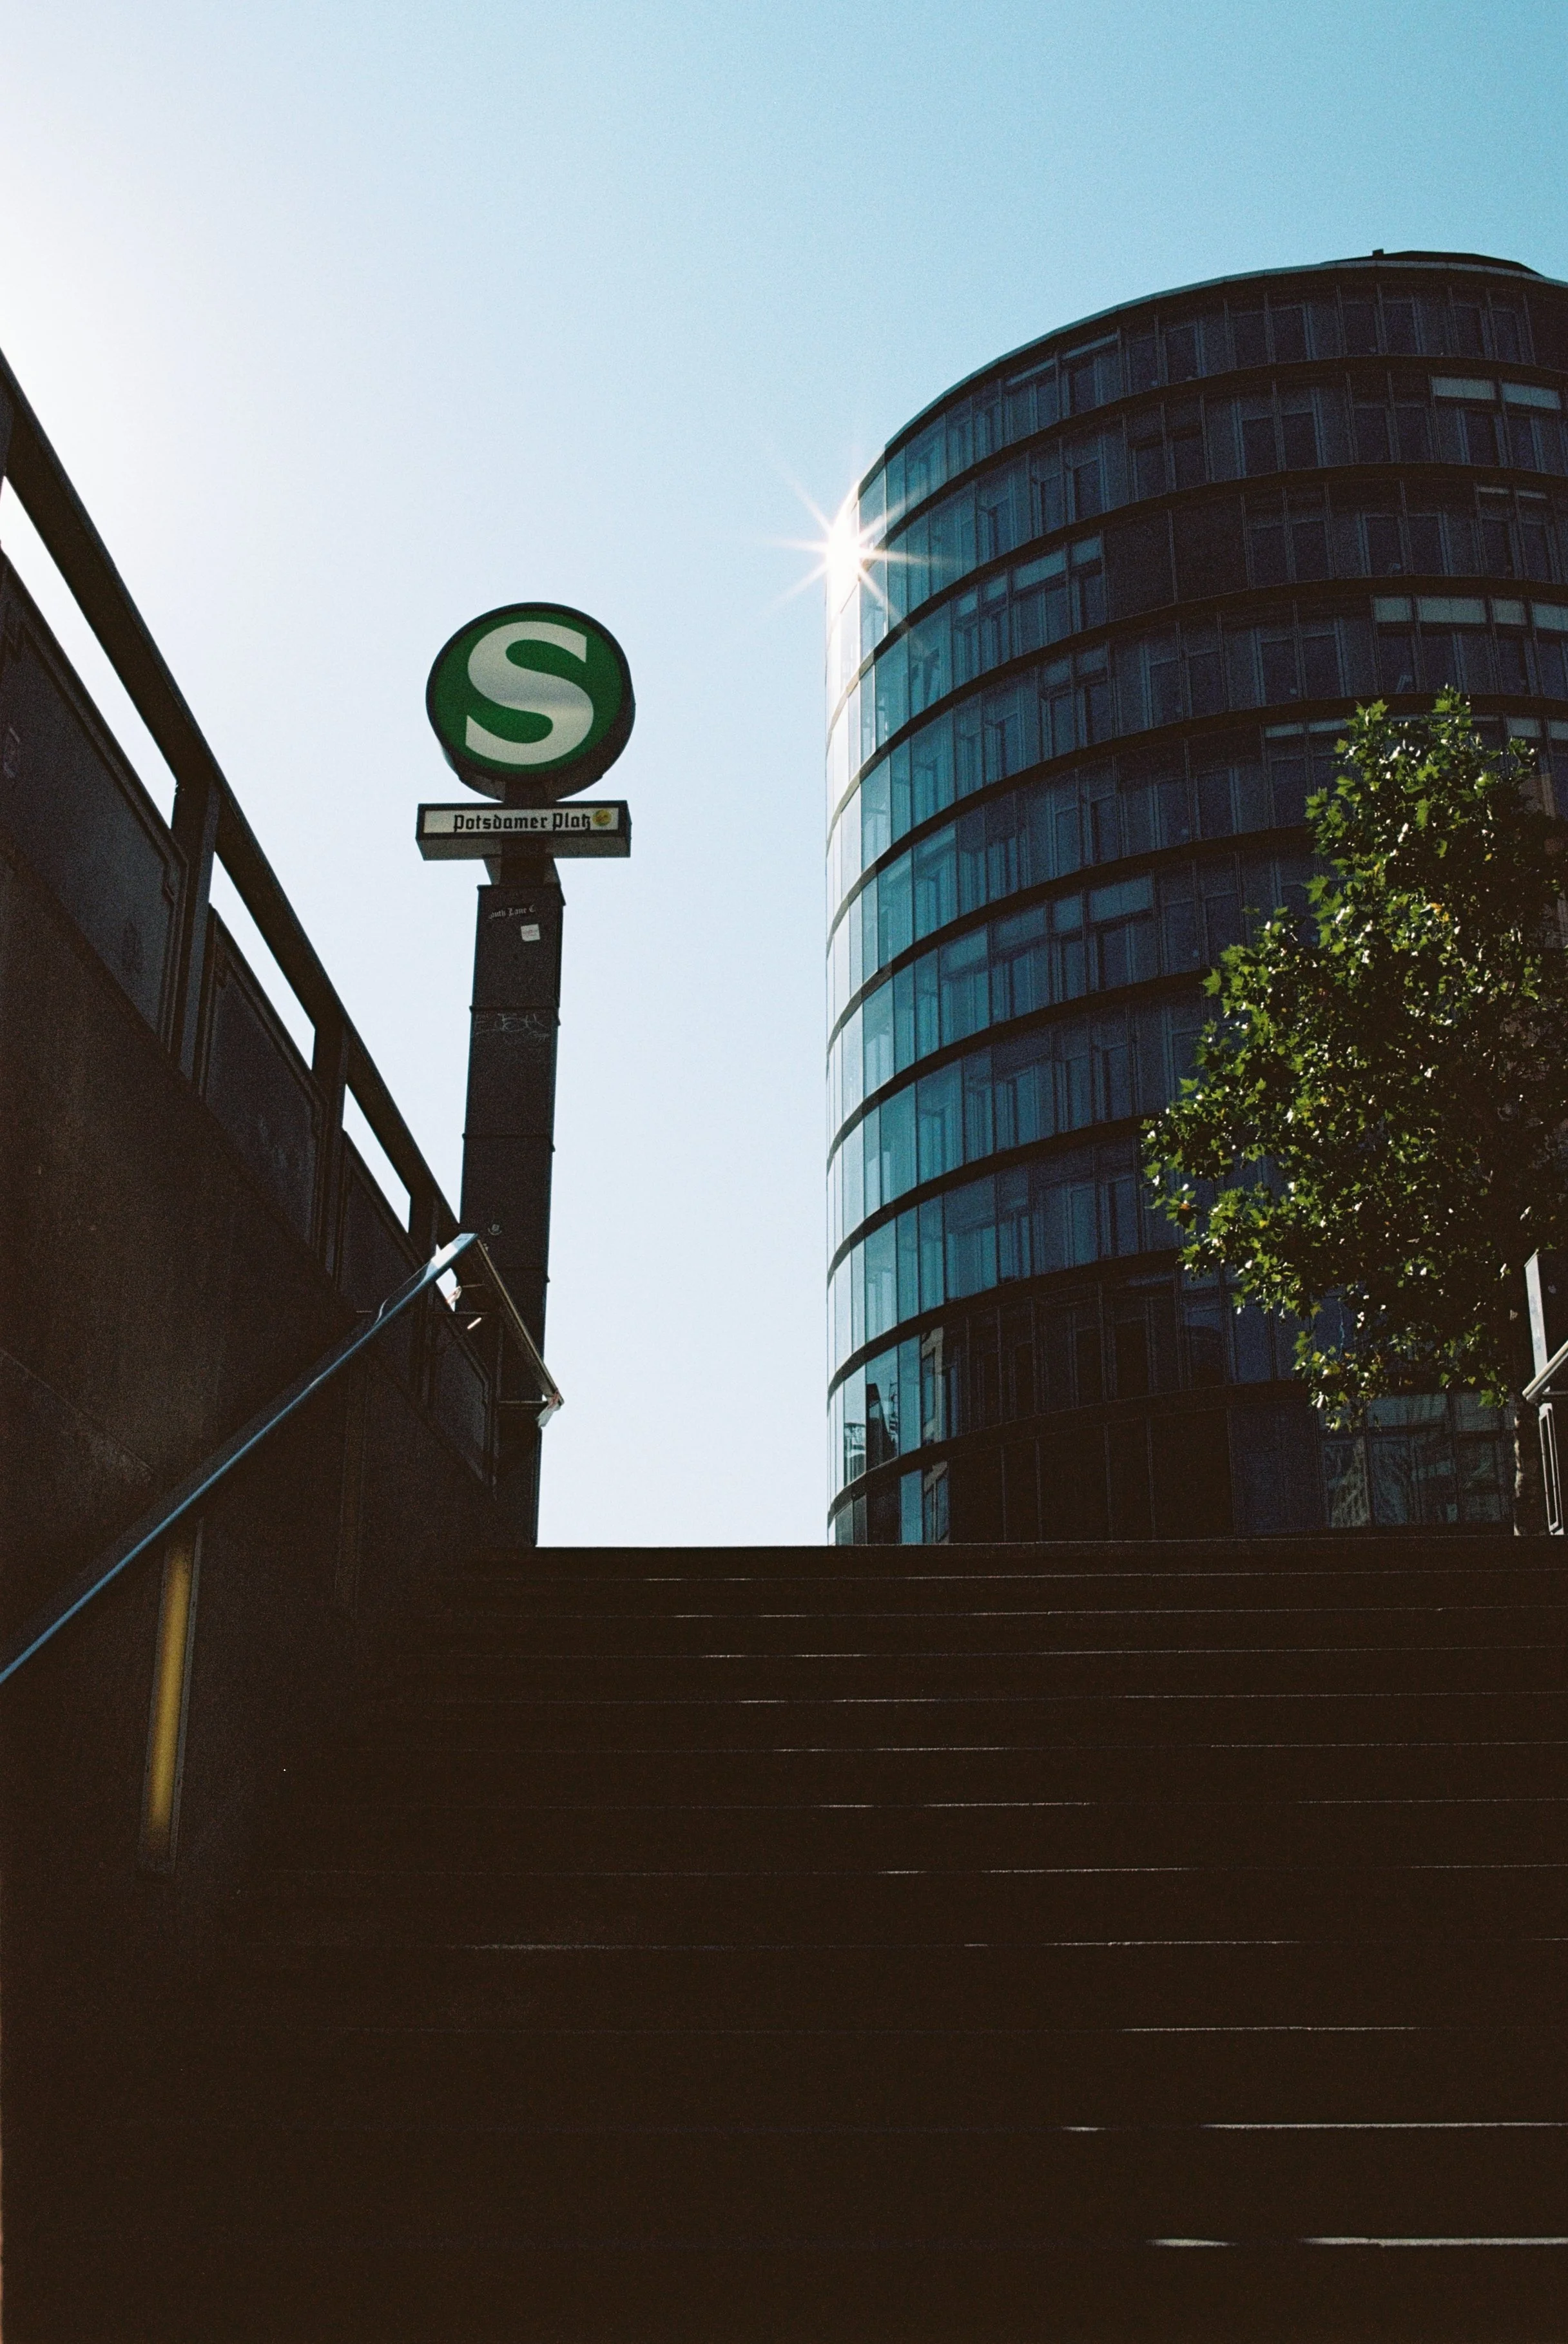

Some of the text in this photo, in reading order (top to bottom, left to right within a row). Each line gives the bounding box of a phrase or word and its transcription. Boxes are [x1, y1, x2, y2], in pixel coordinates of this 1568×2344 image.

[465, 621, 594, 765] S
[453, 812, 591, 833] Potsdamer Platz
